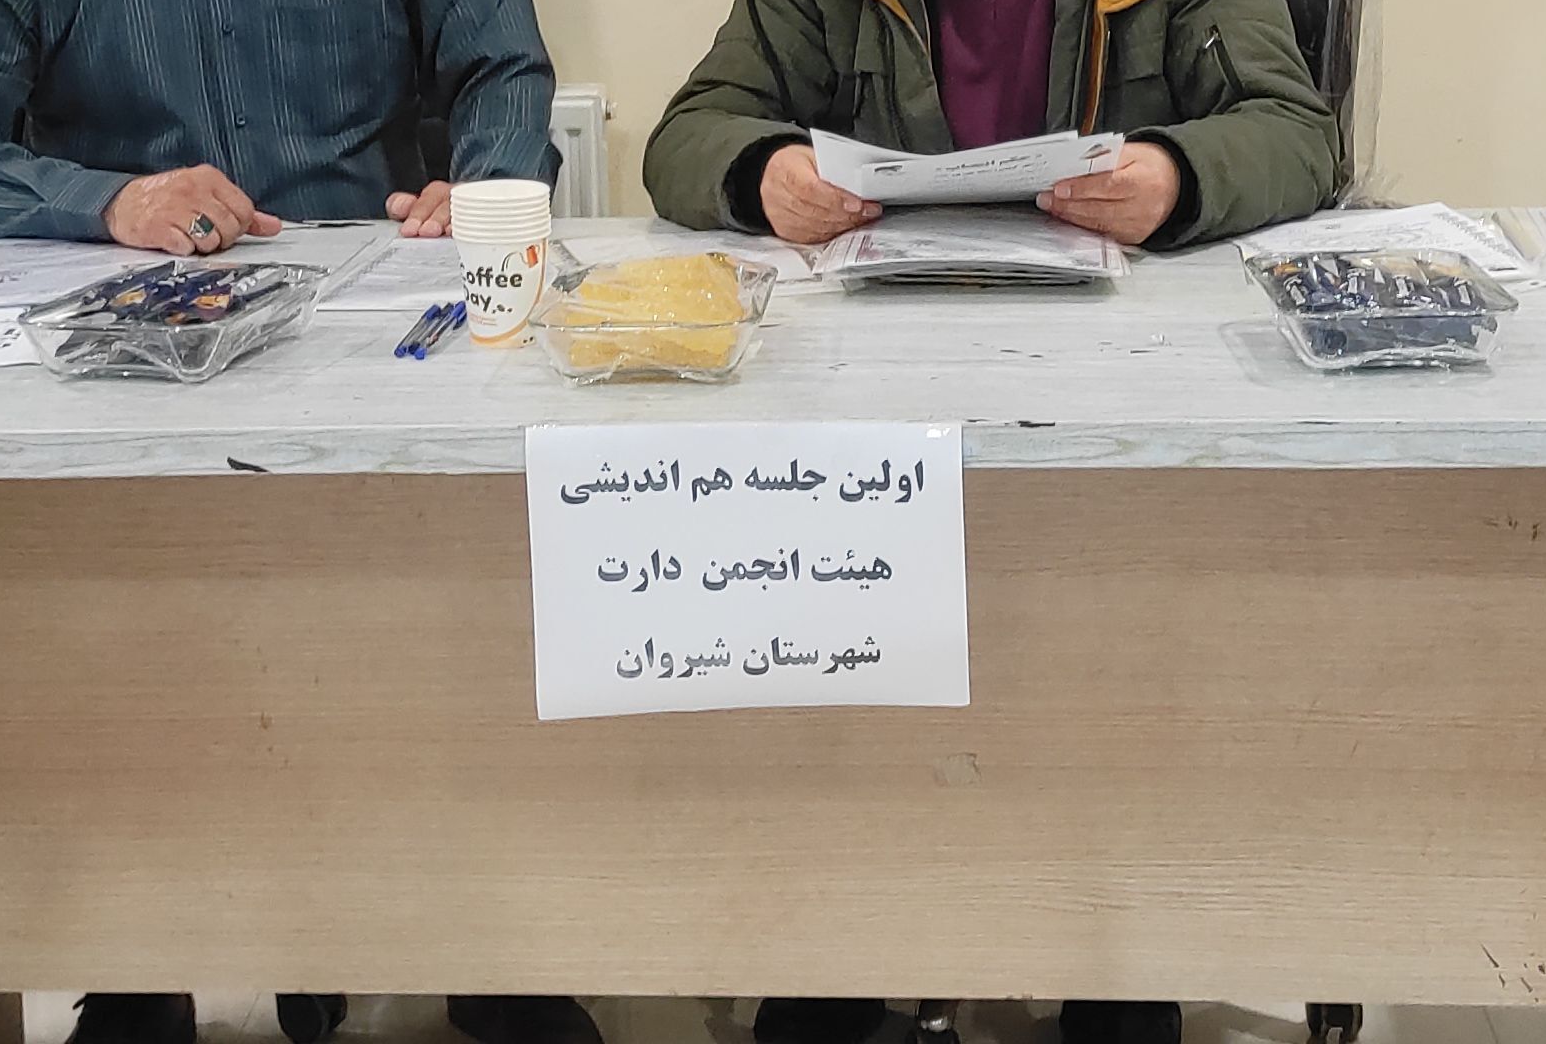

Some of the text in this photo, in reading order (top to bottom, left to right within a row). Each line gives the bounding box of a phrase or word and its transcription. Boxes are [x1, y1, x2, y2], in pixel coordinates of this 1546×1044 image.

[560, 457, 924, 505] اولین جلسه هم اندیشی
[597, 547, 893, 593] هیئت انجمن دارت
[616, 636, 881, 679] شهرستان شیروان
